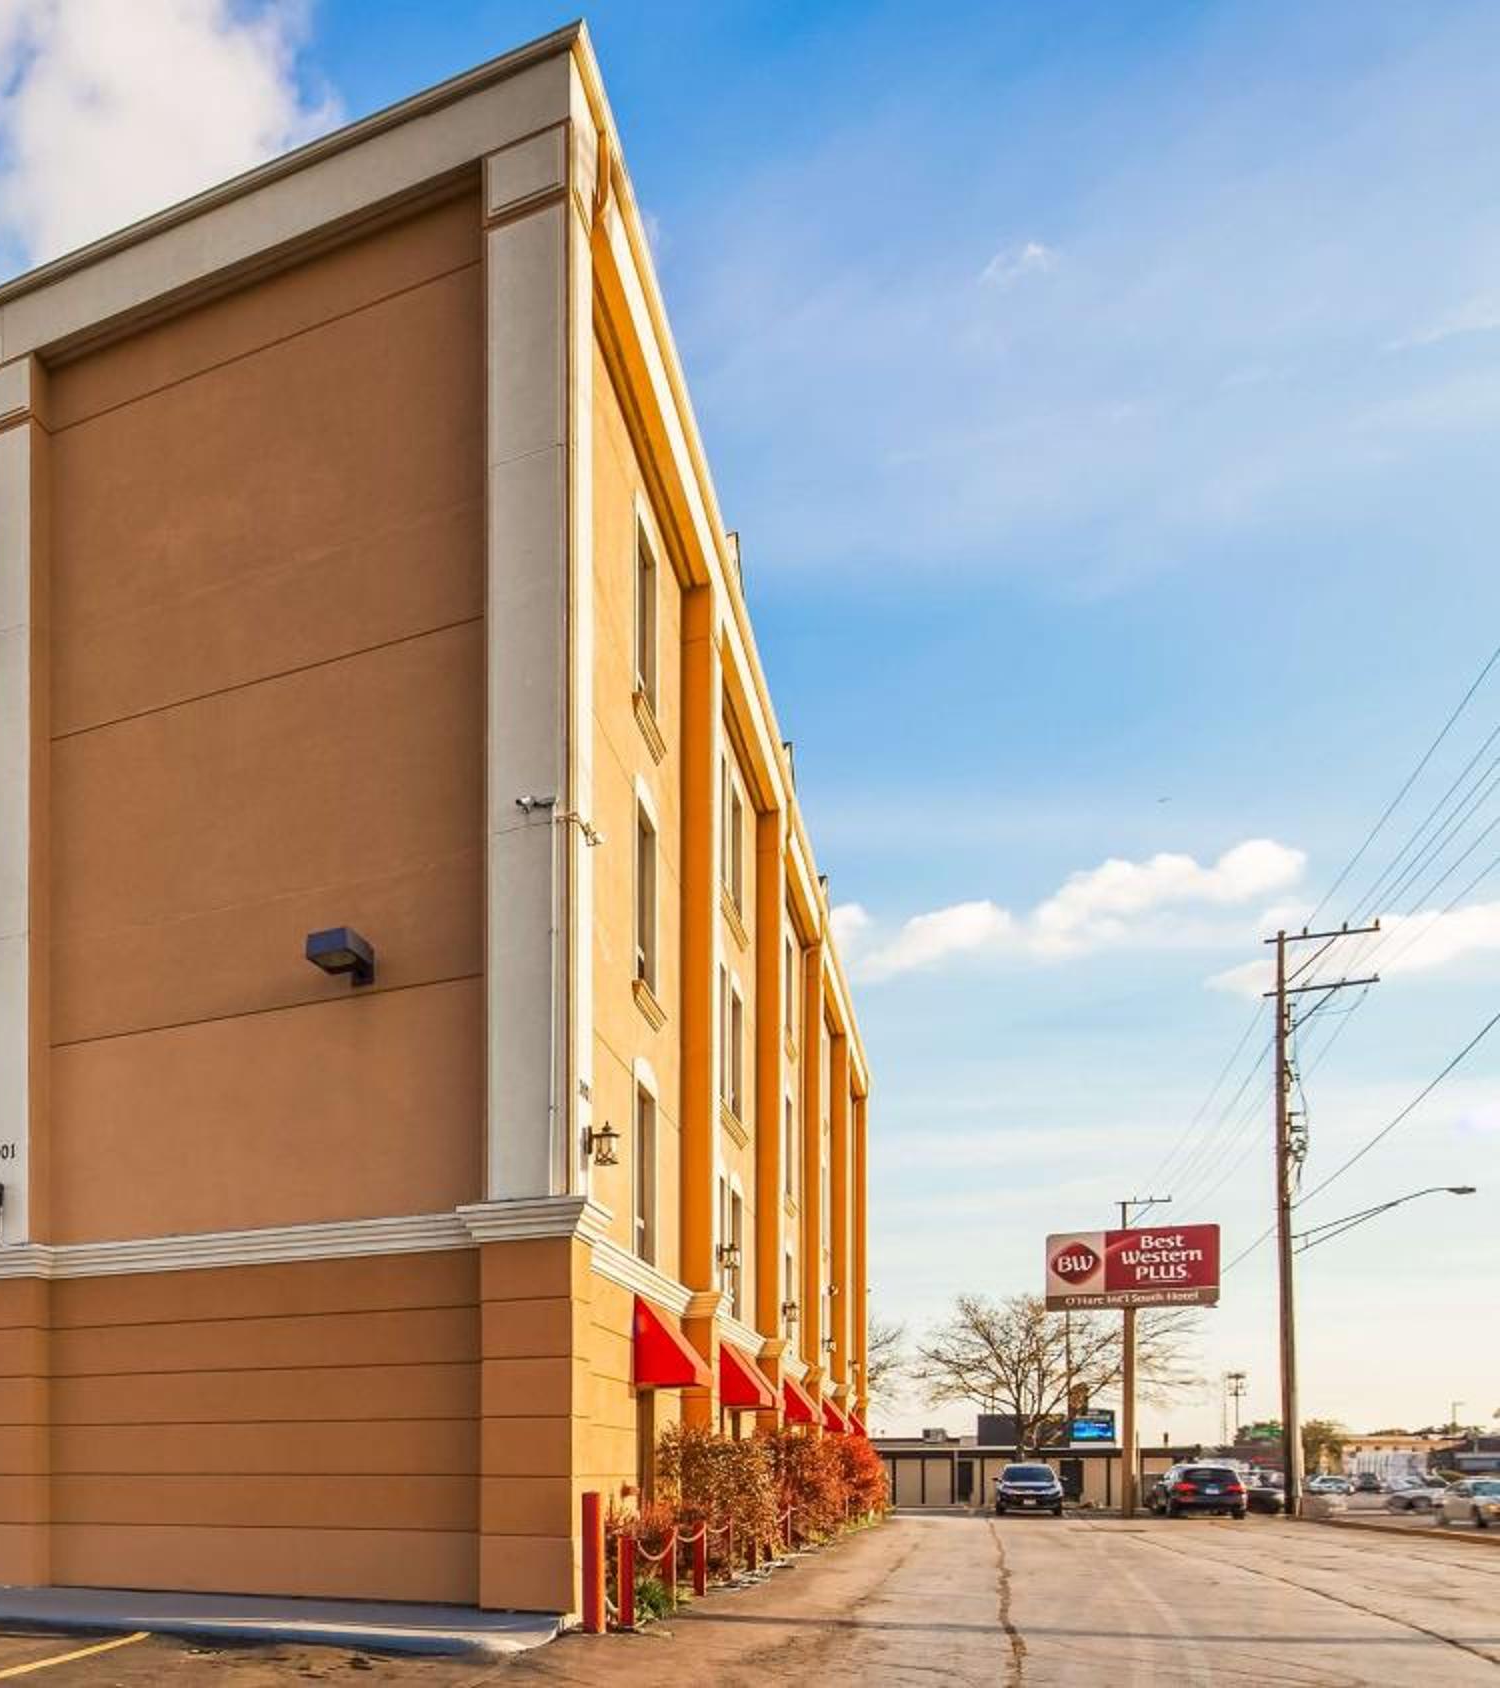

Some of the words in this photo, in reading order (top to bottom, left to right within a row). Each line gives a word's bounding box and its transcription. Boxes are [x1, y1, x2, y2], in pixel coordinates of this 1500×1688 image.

[1140, 1234, 1185, 1249] Best
[1057, 1255, 1094, 1273] BW
[1120, 1248, 1202, 1265] Western
[1135, 1263, 1188, 1280] PLUS
